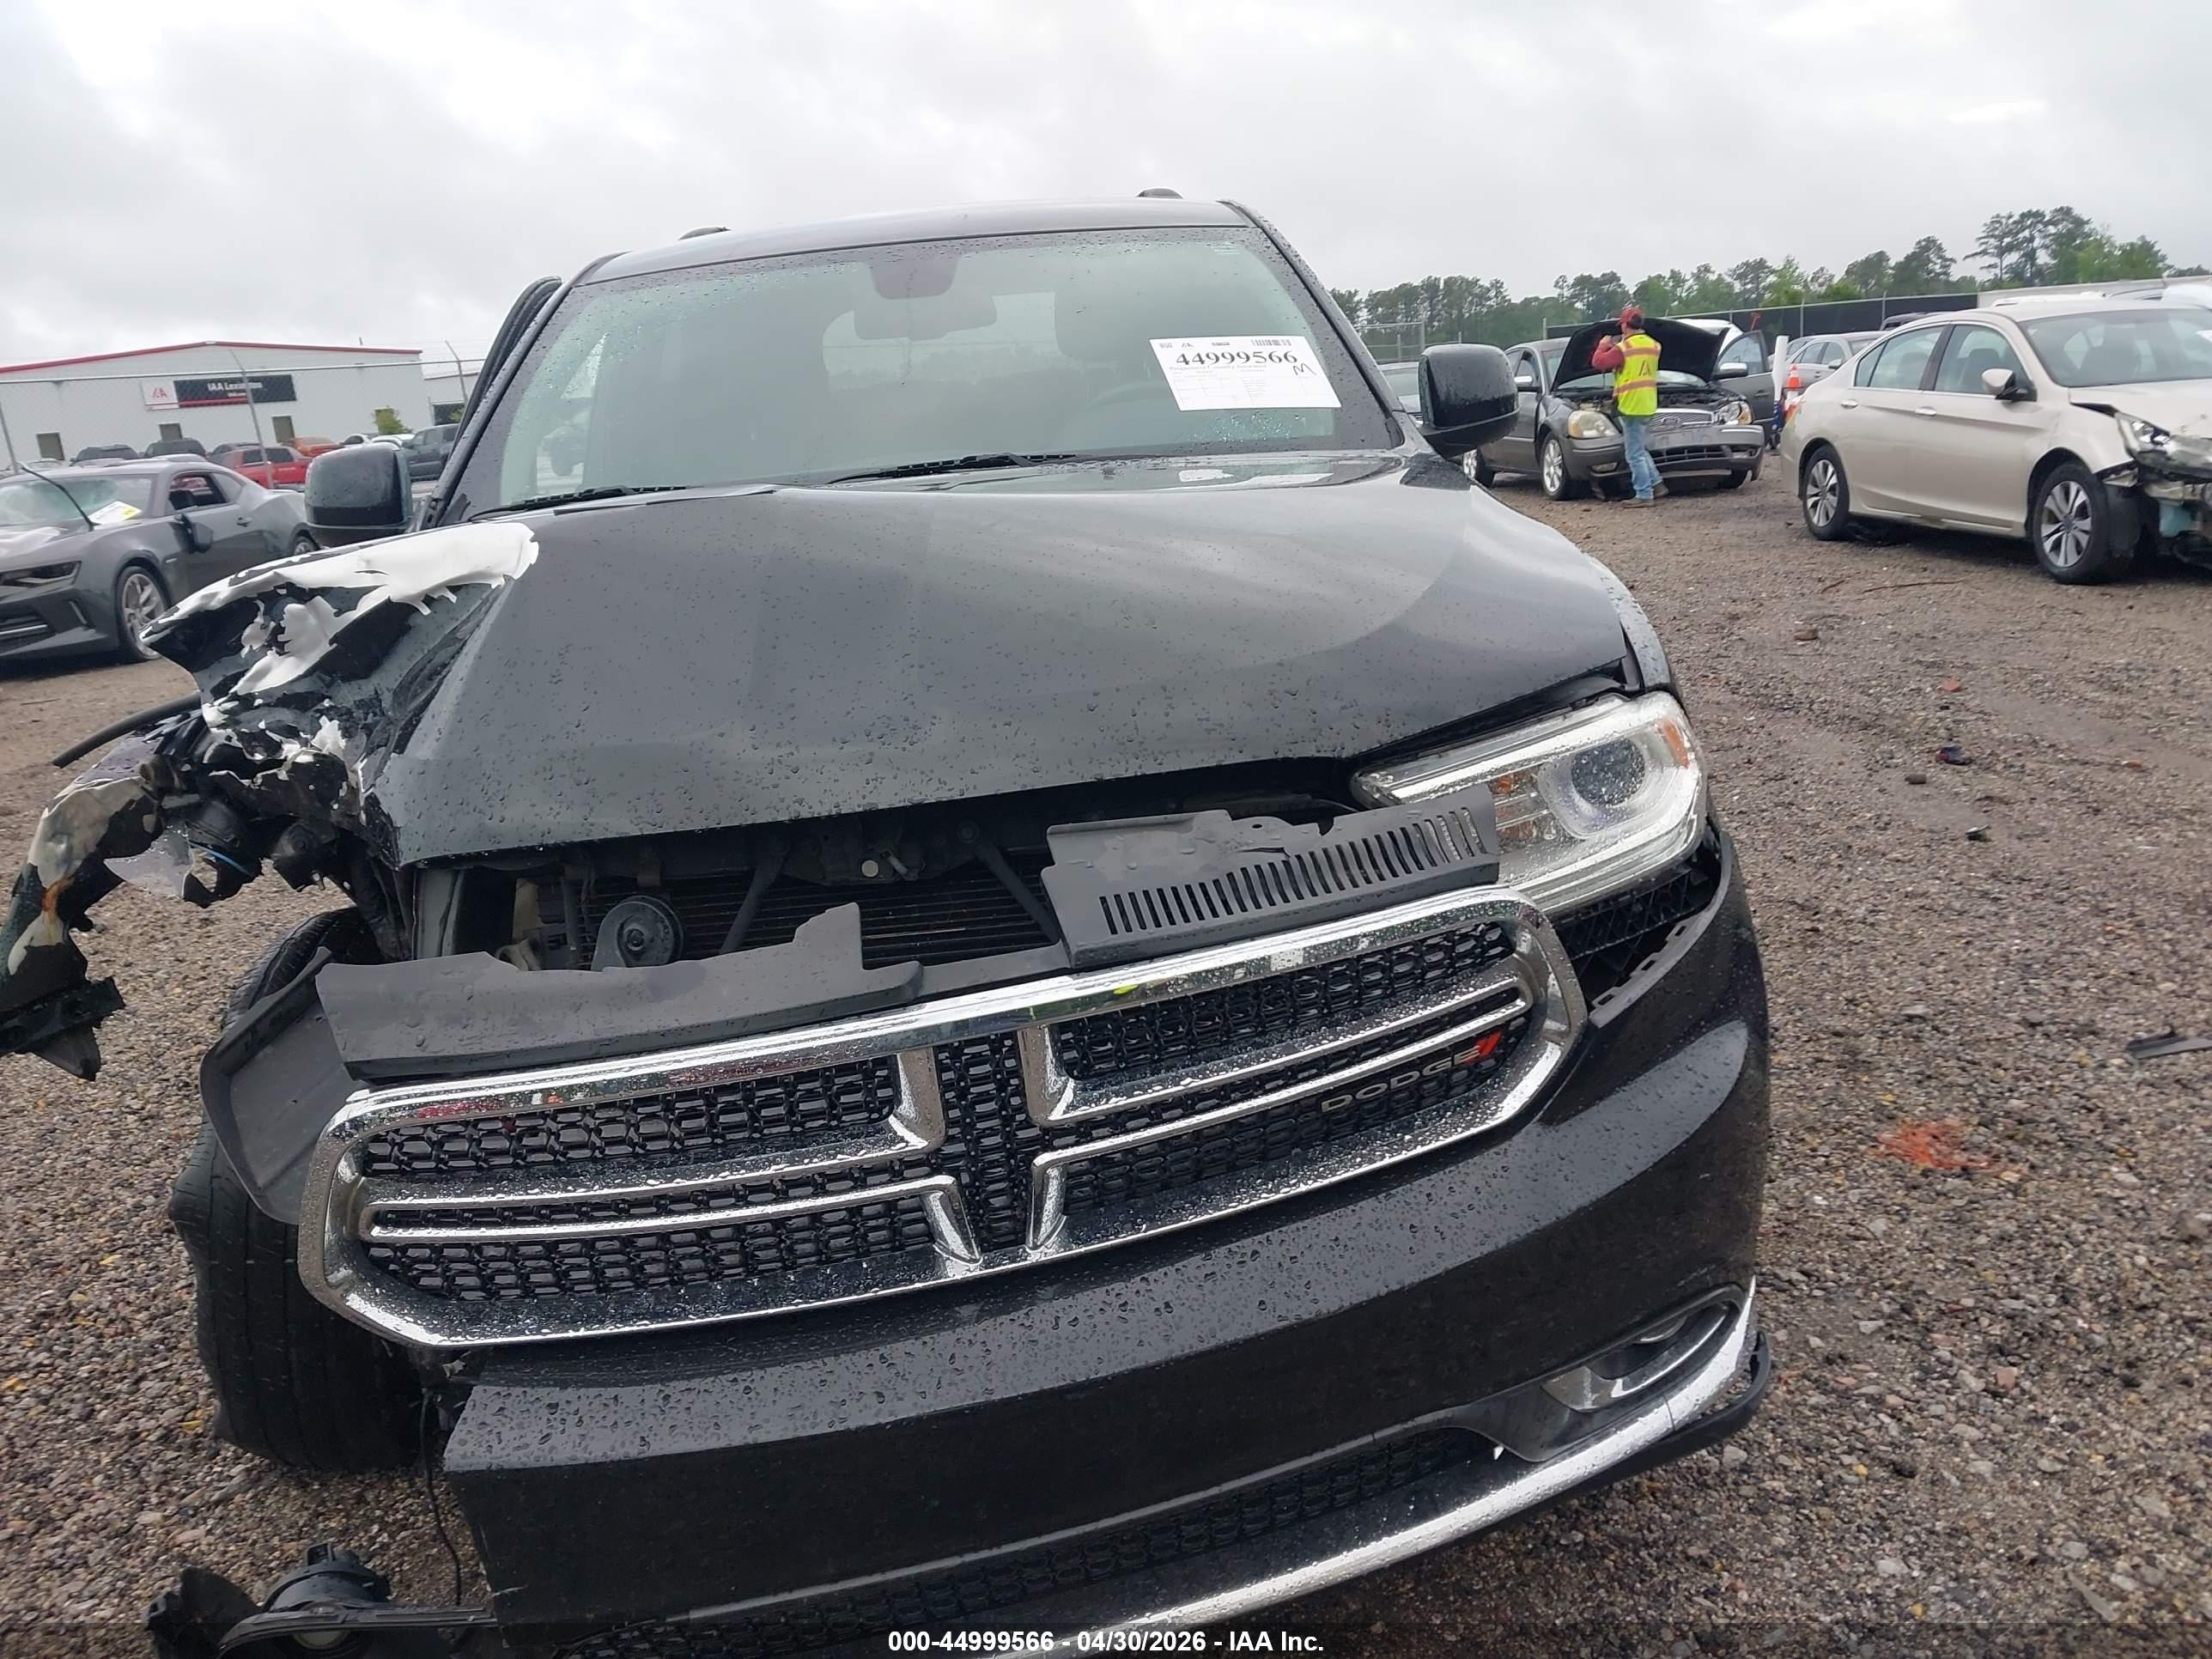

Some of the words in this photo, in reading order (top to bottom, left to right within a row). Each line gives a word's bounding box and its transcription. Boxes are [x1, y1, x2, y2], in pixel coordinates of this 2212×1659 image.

[1176, 350, 1298, 366] 44999566
[207, 382, 224, 392] IAA
[1321, 1044, 1480, 1113] DODGE
